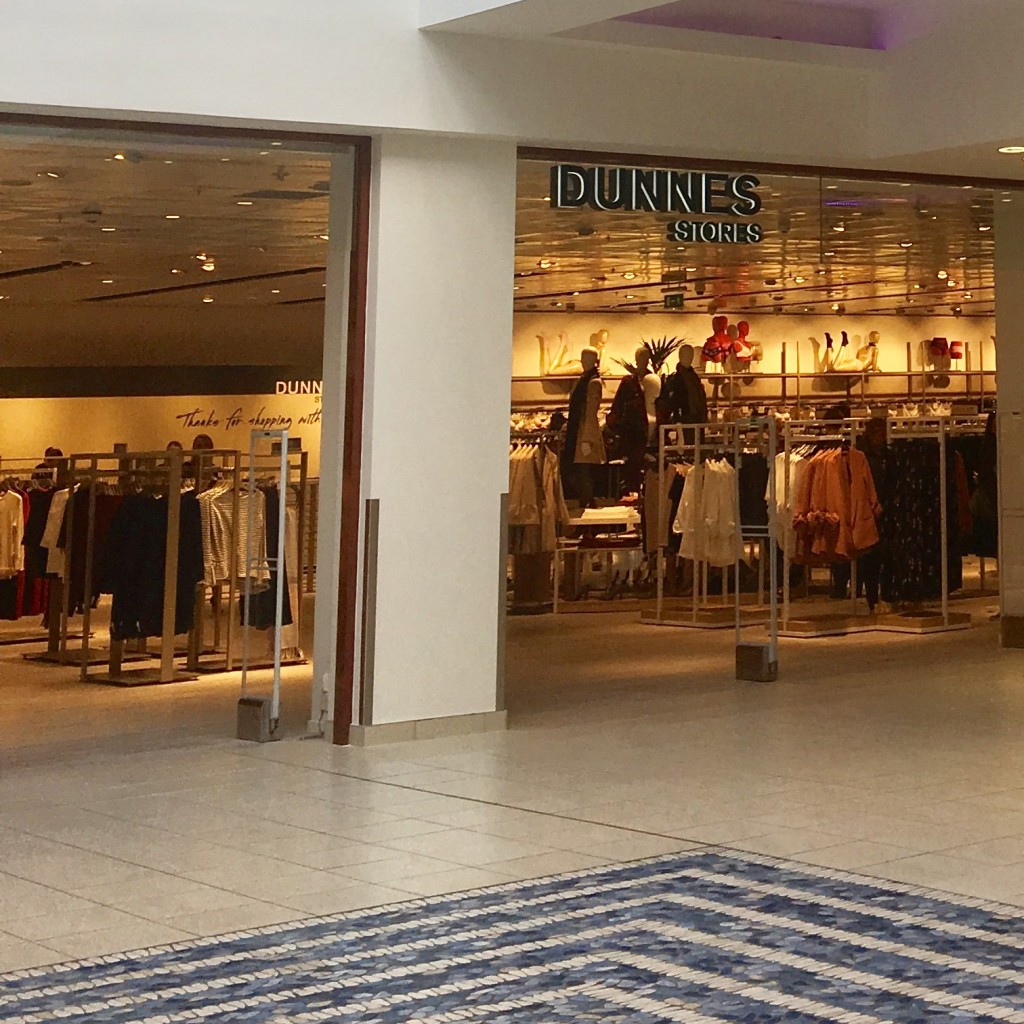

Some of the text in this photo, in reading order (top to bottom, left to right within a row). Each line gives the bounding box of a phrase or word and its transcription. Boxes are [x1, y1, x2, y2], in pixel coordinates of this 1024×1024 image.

[551, 164, 762, 216] DUNNES
[667, 220, 762, 243] STORES
[176, 408, 219, 428] Thanks
[225, 407, 243, 431] for
[249, 406, 292, 429] shopping
